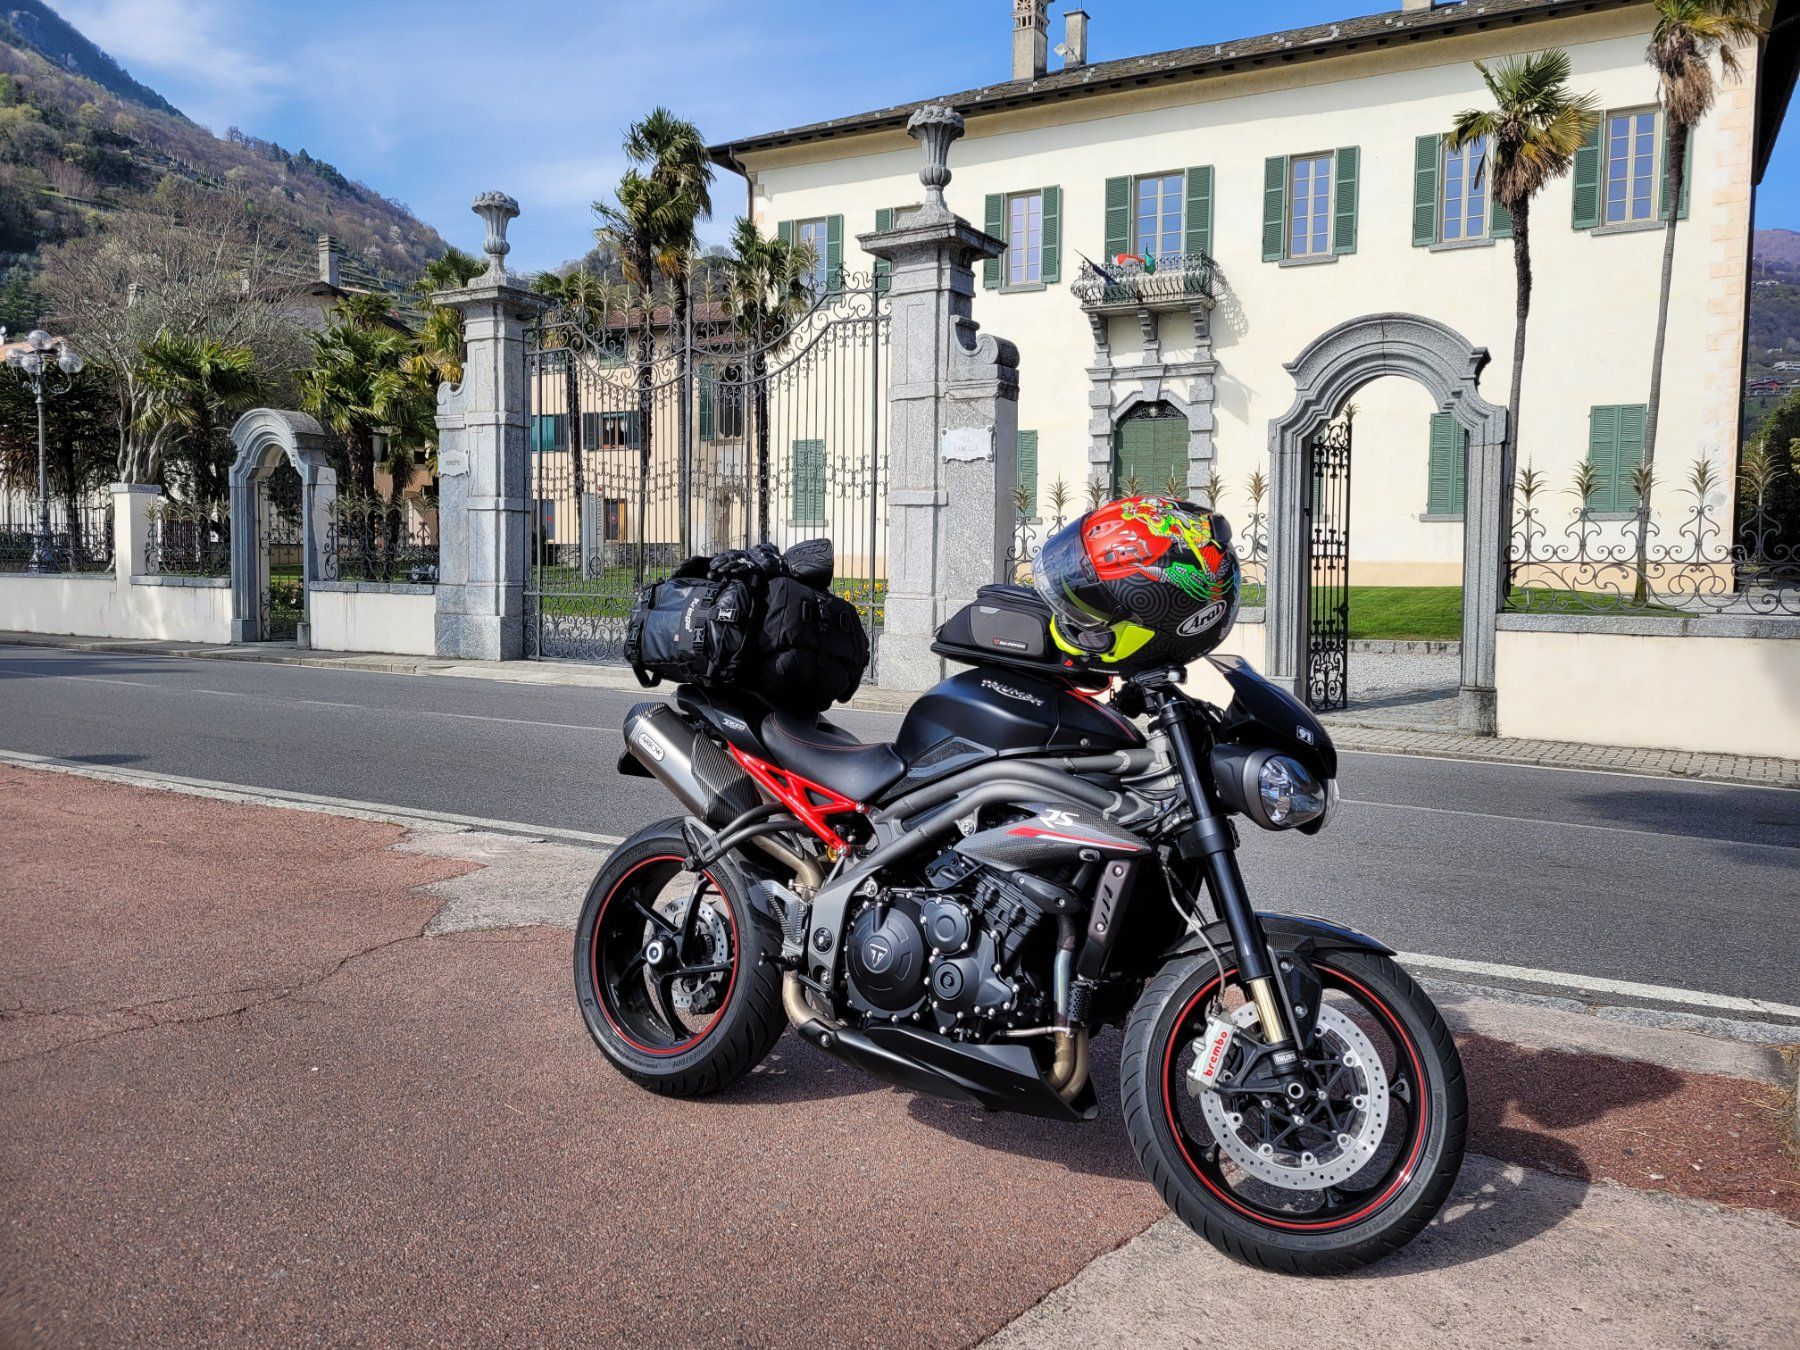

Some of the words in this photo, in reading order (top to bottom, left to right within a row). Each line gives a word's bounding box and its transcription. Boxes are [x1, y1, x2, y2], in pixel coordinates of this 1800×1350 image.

[685, 598, 700, 631] Kriega
[1183, 603, 1221, 632] Arai
[981, 680, 1044, 706] TRIUMPH
[641, 735, 663, 757] ARROW
[1038, 808, 1080, 829] RS
[1203, 1031, 1228, 1077] brembo
